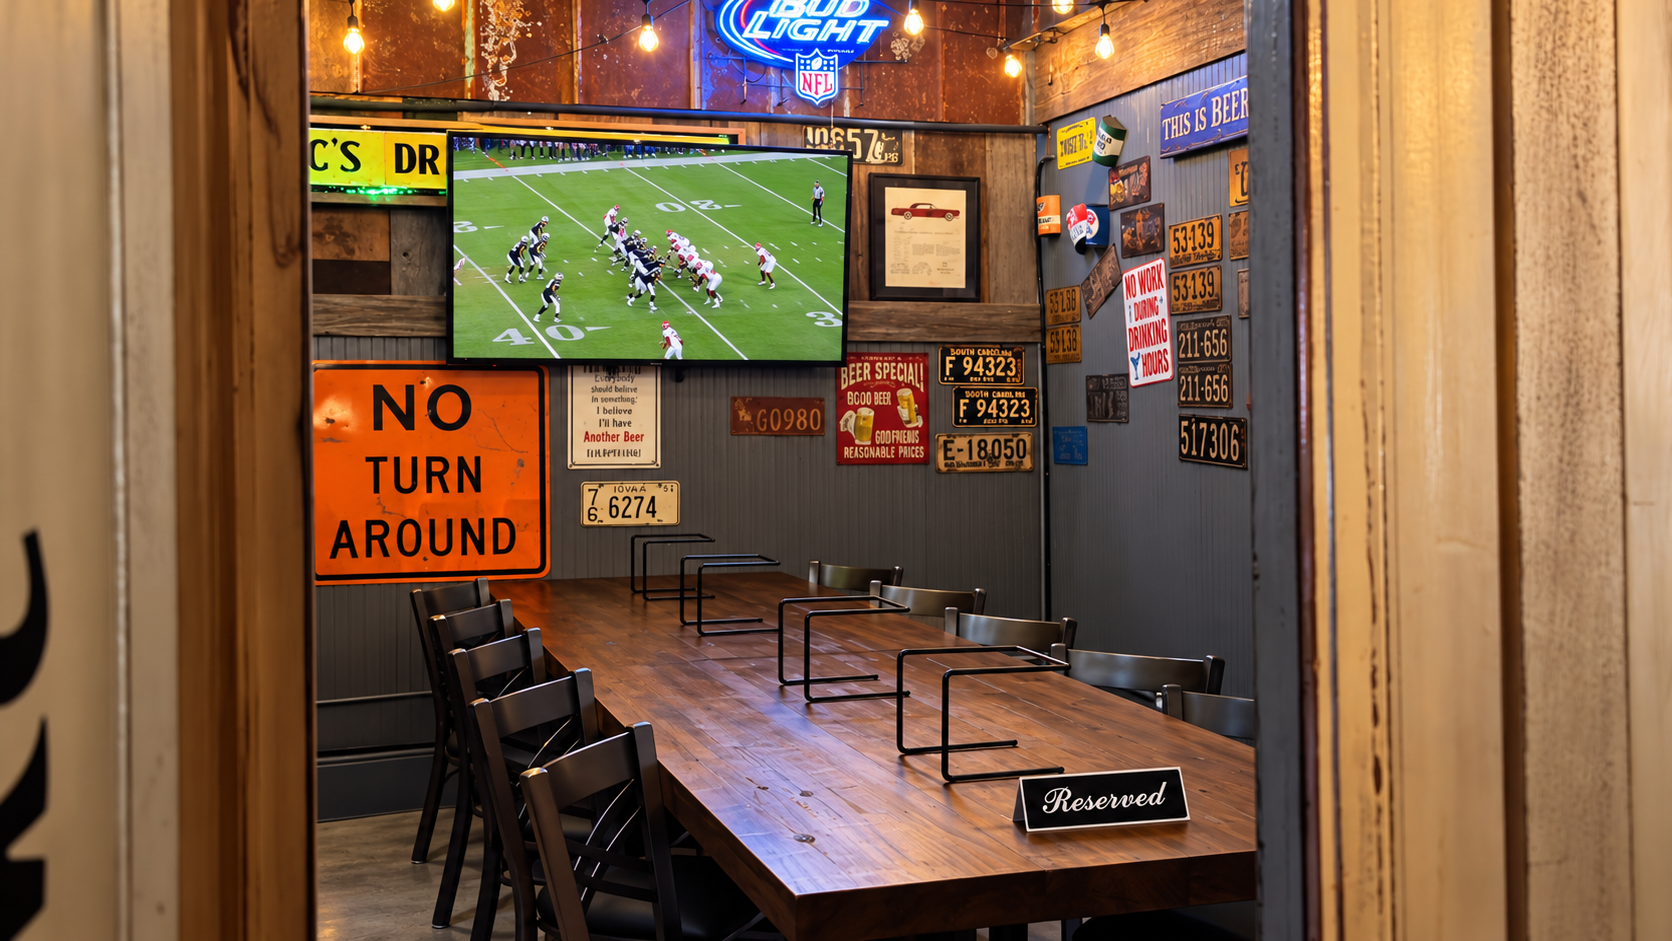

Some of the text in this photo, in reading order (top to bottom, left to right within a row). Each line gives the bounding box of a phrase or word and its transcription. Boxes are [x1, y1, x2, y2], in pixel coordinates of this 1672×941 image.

[769, 0, 870, 18] BUD
[742, 10, 889, 44] LIGHT
[802, 72, 833, 96] NFL
[1162, 88, 1249, 141] THIS IS BEER
[394, 142, 440, 175] DR
[1124, 263, 1164, 300] NO WORK
[1133, 296, 1159, 322] DURING
[1128, 318, 1168, 352] DRINKING
[945, 356, 1017, 376] F 94323
[1141, 348, 1169, 377] HOURS
[591, 385, 613, 393] should
[841, 362, 925, 393] BEER SPECIAL!
[373, 384, 473, 432] NO
[959, 398, 1030, 418] F 94323
[583, 431, 645, 443] Another Beer
[598, 418, 632, 428] I'll have
[843, 446, 925, 459] REASONABLE PRICES
[943, 438, 1027, 461] E-18050
[1181, 420, 1240, 462] 517306
[365, 456, 481, 495] TURN
[608, 495, 657, 519] 6274
[329, 517, 517, 560] AROUND
[1042, 781, 1168, 814] Reserved
